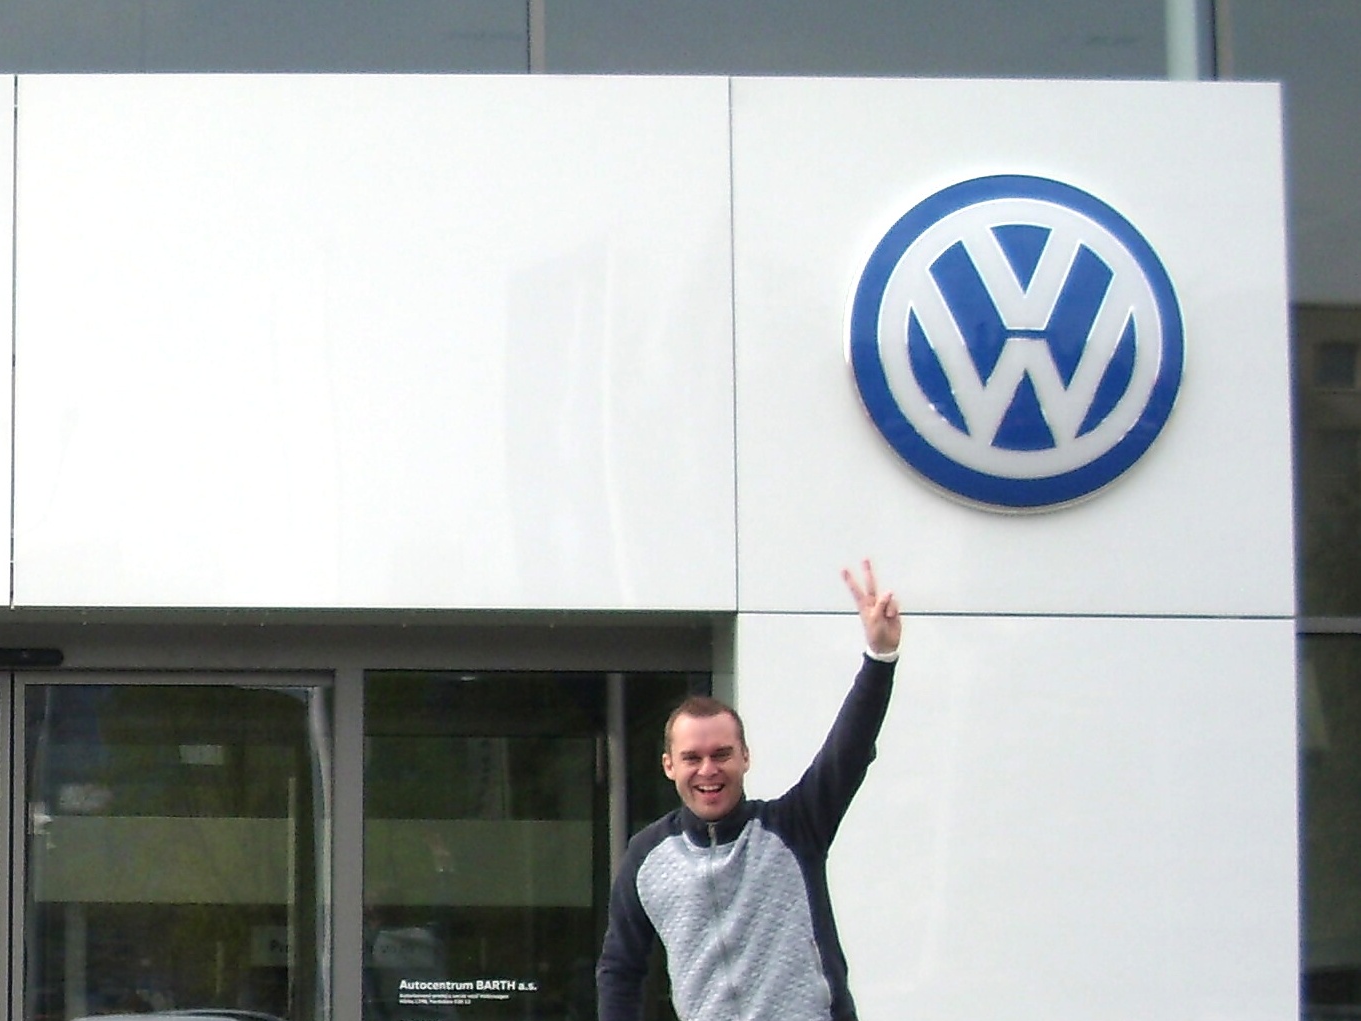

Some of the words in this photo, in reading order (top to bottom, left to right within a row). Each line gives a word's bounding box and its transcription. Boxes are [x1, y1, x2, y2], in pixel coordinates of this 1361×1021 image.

[878, 197, 1161, 478] VW
[399, 980, 473, 990] Autocentrum
[476, 980, 516, 990] BARTH
[517, 981, 537, 991] a.s.
